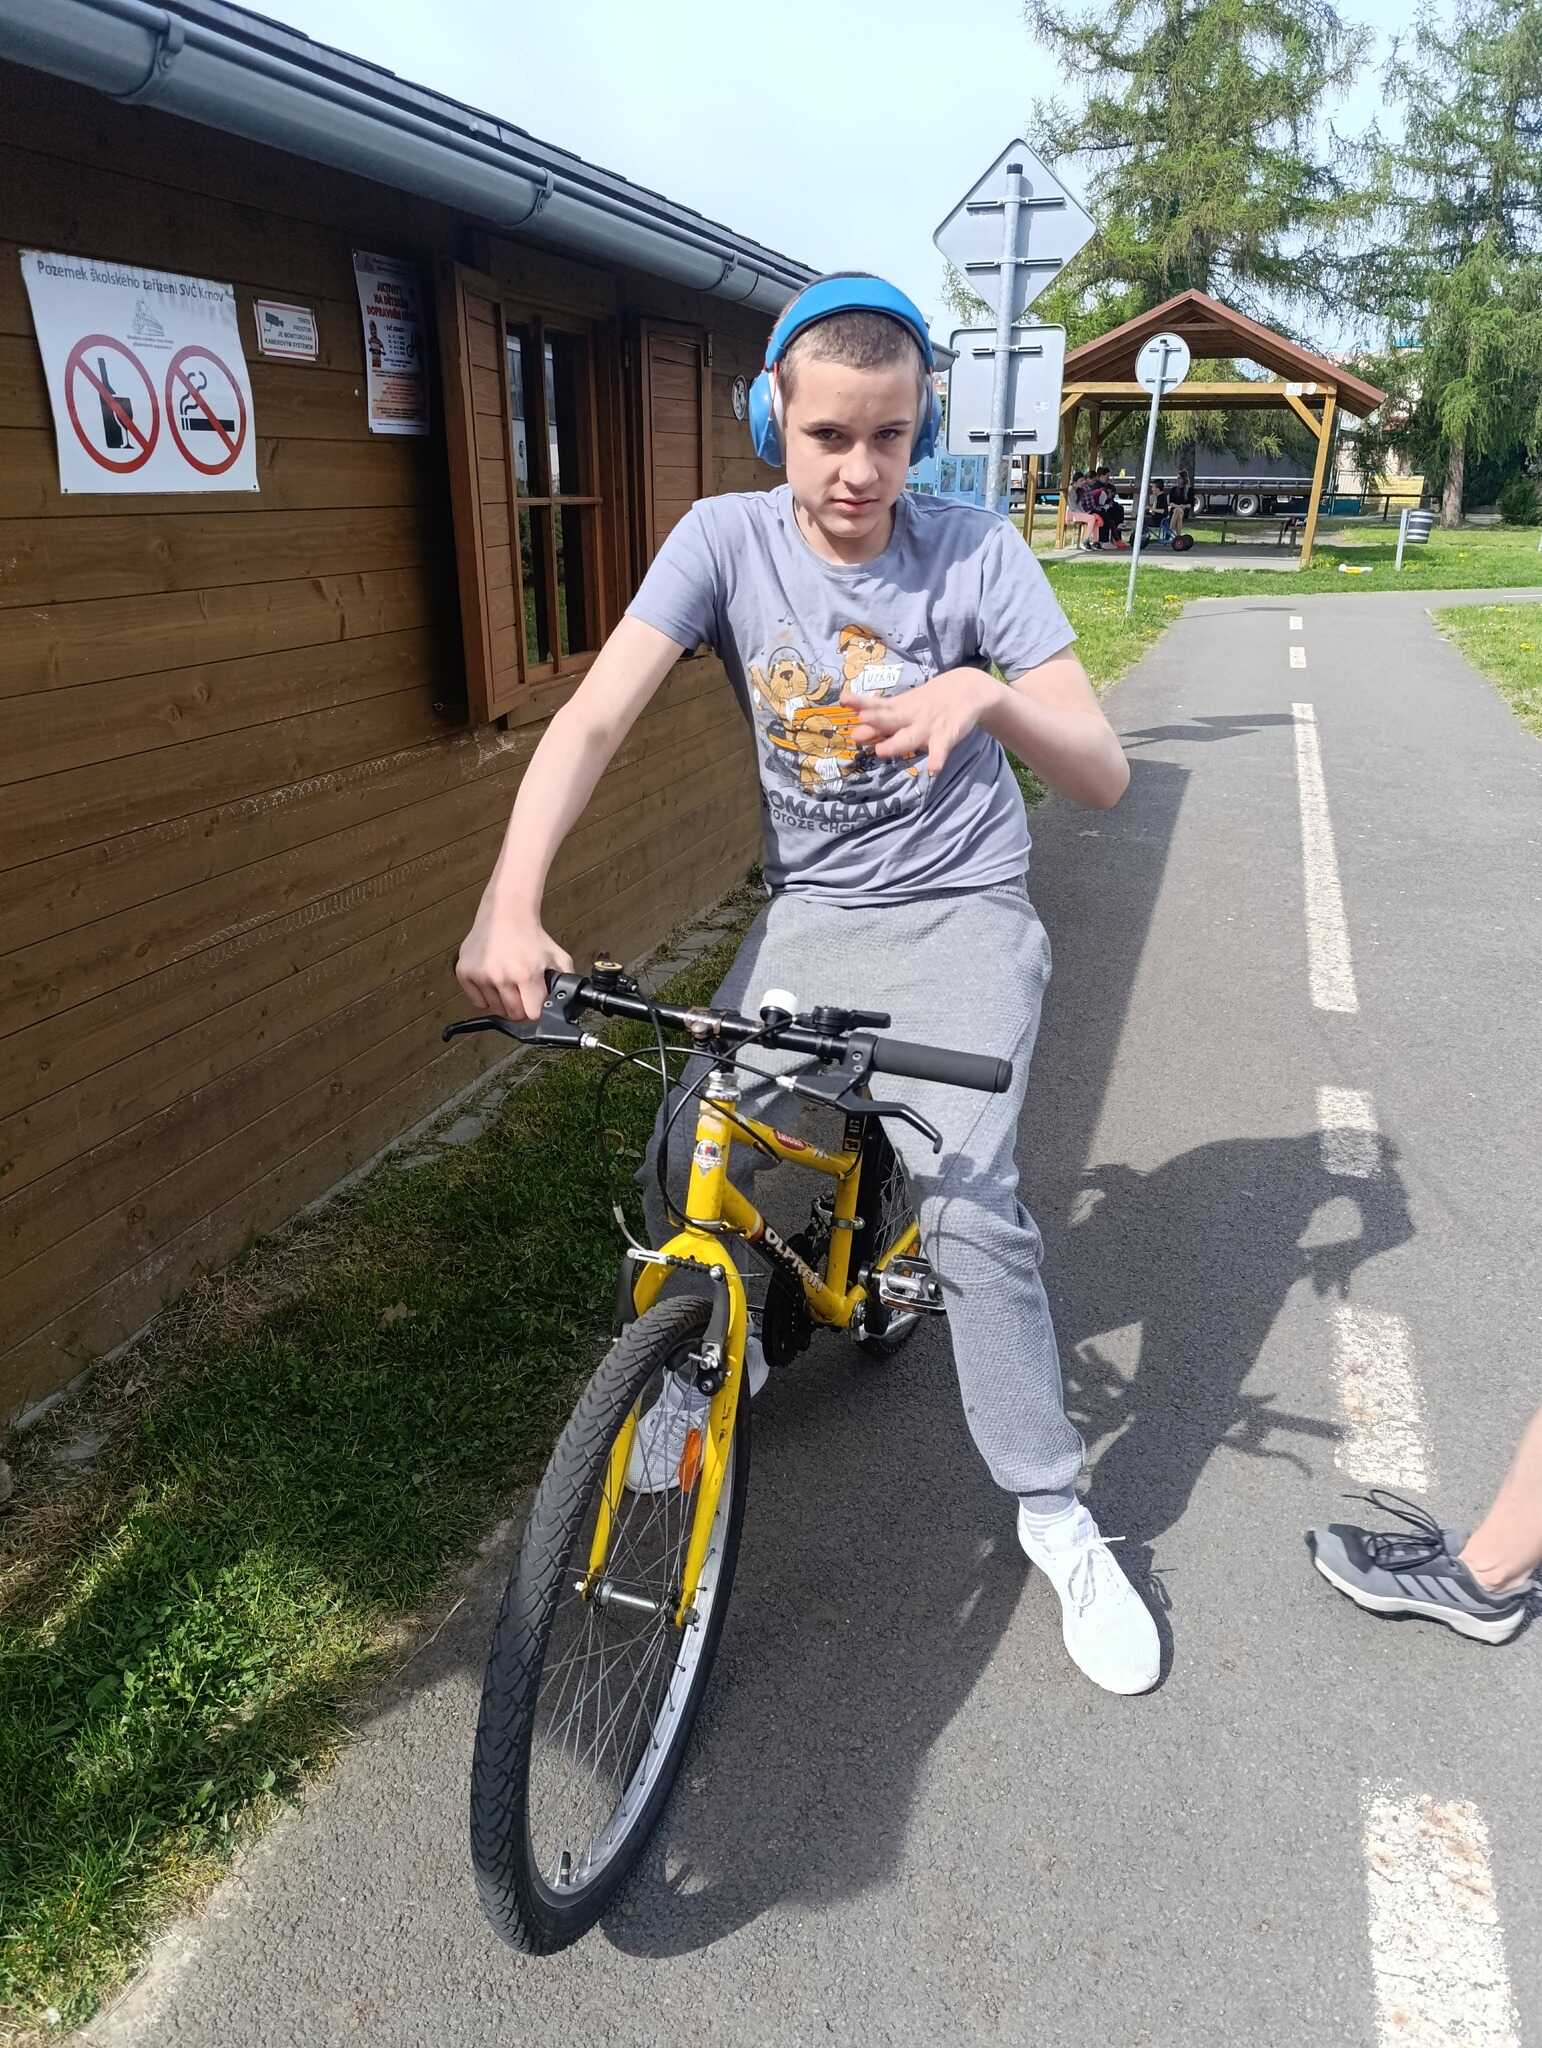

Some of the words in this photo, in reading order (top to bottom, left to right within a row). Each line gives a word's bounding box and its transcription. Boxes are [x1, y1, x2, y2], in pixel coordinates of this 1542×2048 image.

[37, 260, 88, 280] Pozemek
[179, 282, 198, 298] SVČ
[198, 287, 224, 302] Krnov
[769, 790, 901, 823] OMAHAM
[773, 809, 814, 830] OTOZE
